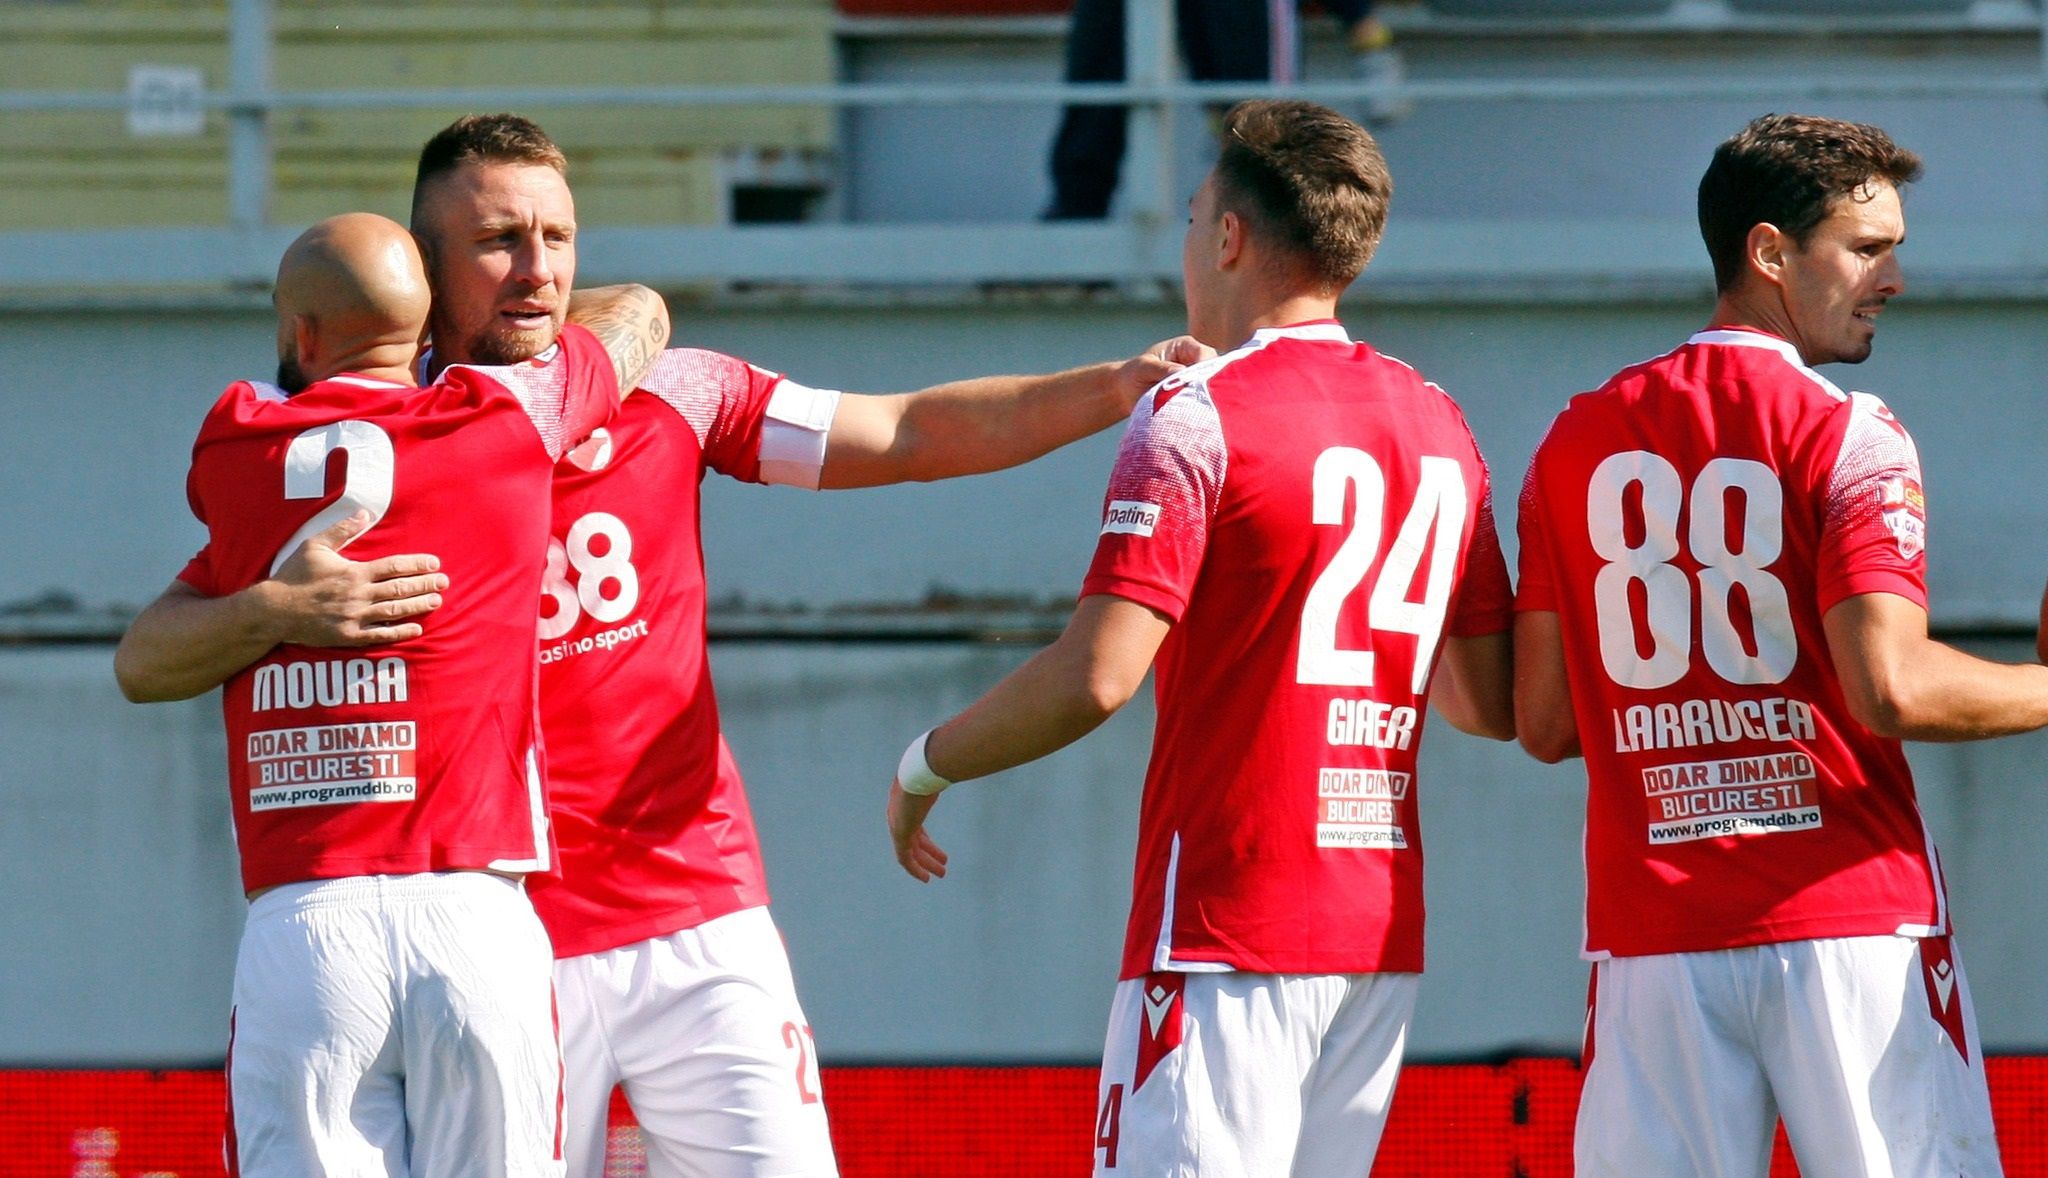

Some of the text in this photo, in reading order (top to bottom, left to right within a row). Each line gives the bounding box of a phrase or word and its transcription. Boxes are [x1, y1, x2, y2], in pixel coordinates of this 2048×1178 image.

[269, 419, 395, 577] 2
[1296, 446, 1467, 695] 24
[1587, 450, 1798, 689] 88
[538, 619, 649, 664] asino sport
[252, 656, 408, 713] MOURA
[250, 724, 412, 758] DOAR DINAMO
[1613, 697, 1816, 753] LARRUCEA
[261, 753, 399, 785] BUCURESTI
[1322, 772, 1361, 793] DOAR
[1644, 755, 1811, 793] DOAR DINAMO
[252, 781, 414, 805] www.programddb.ro
[1661, 784, 1802, 819] BUCURESTI
[1651, 811, 1820, 838] www.programddb.ro
[781, 1021, 818, 1105] 2
